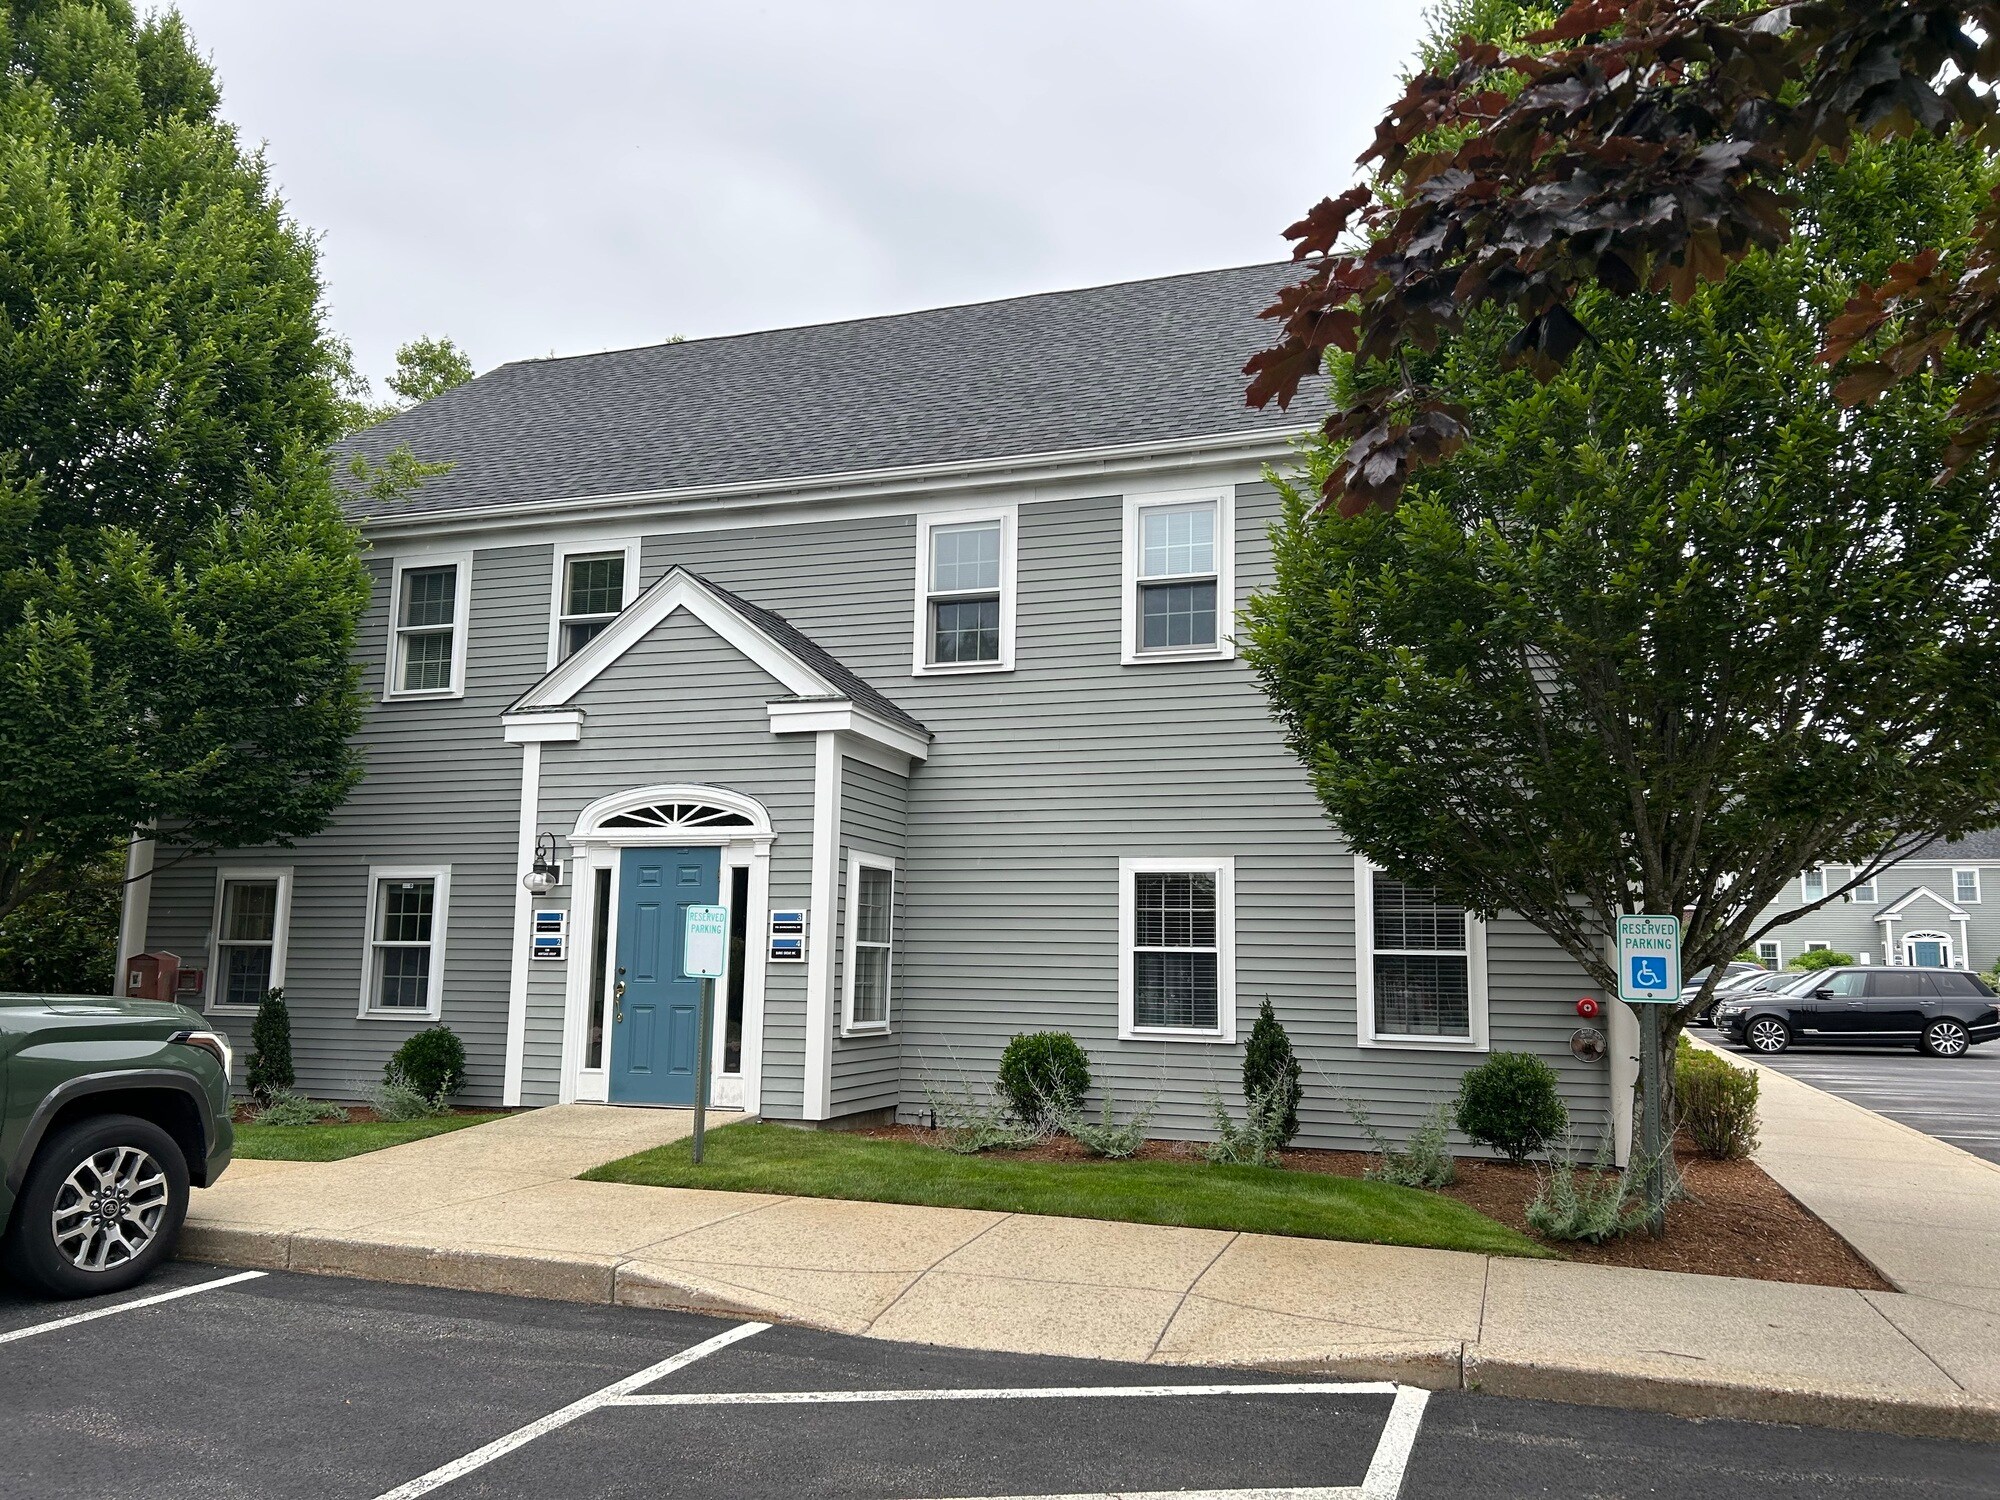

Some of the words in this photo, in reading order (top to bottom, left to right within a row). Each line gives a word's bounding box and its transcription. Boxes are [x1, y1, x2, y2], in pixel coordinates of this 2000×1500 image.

[690, 912, 725, 922] RESERVED
[796, 913, 802, 921] 3
[691, 924, 722, 934] PARKING
[1622, 923, 1674, 935] RESERVED
[556, 938, 561, 946] 2
[1625, 938, 1672, 950] PARKING
